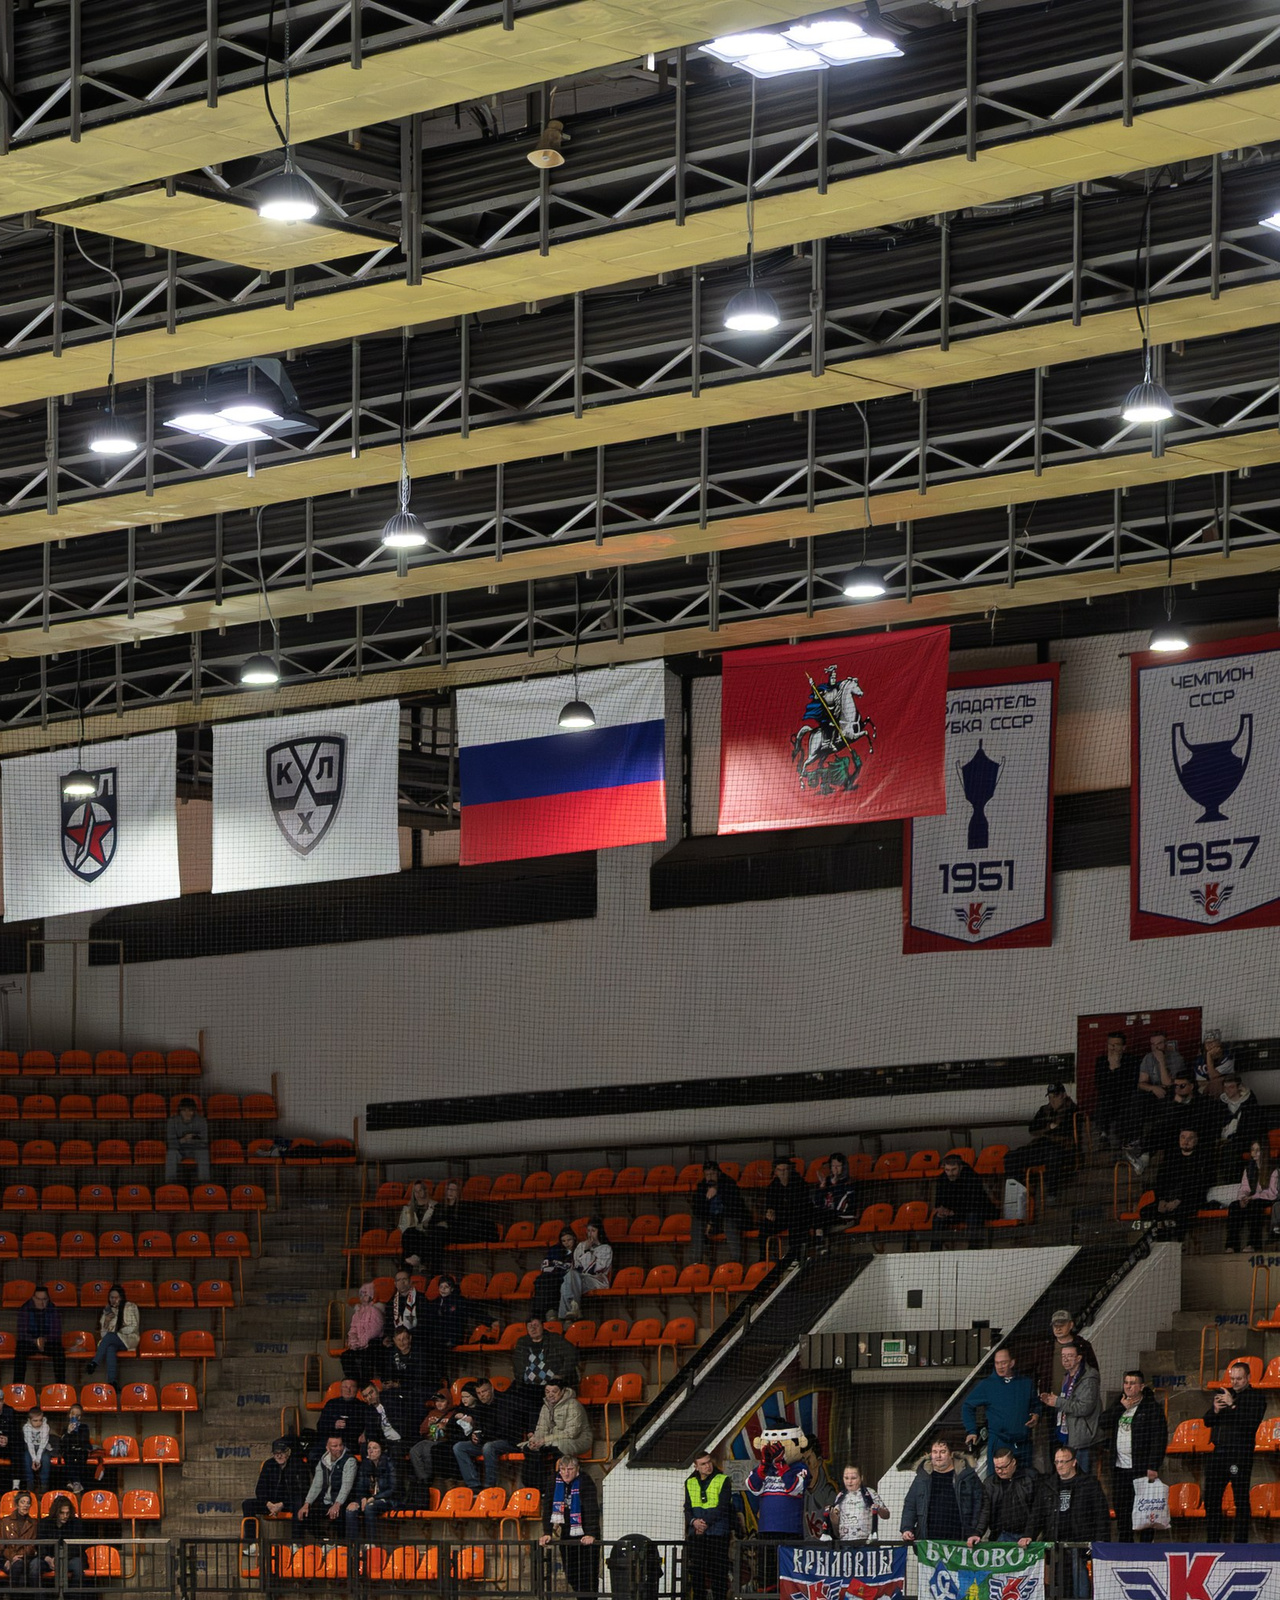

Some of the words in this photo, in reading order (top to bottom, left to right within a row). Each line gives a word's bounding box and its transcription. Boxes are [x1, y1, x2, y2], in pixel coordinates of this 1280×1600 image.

[1171, 667, 1254, 690] ЧЕМПИОН
[945, 694, 1037, 715] ЛАДАТЕЛЬ
[1189, 689, 1235, 708] СССР
[945, 719, 982, 734] БКА
[990, 714, 1033, 730] СССР
[1164, 835, 1261, 877] 1957
[938, 859, 1015, 894] 1951
[793, 1548, 893, 1579] КРЫЛОВЦЫ
[926, 1540, 1025, 1568] БУТОВО
